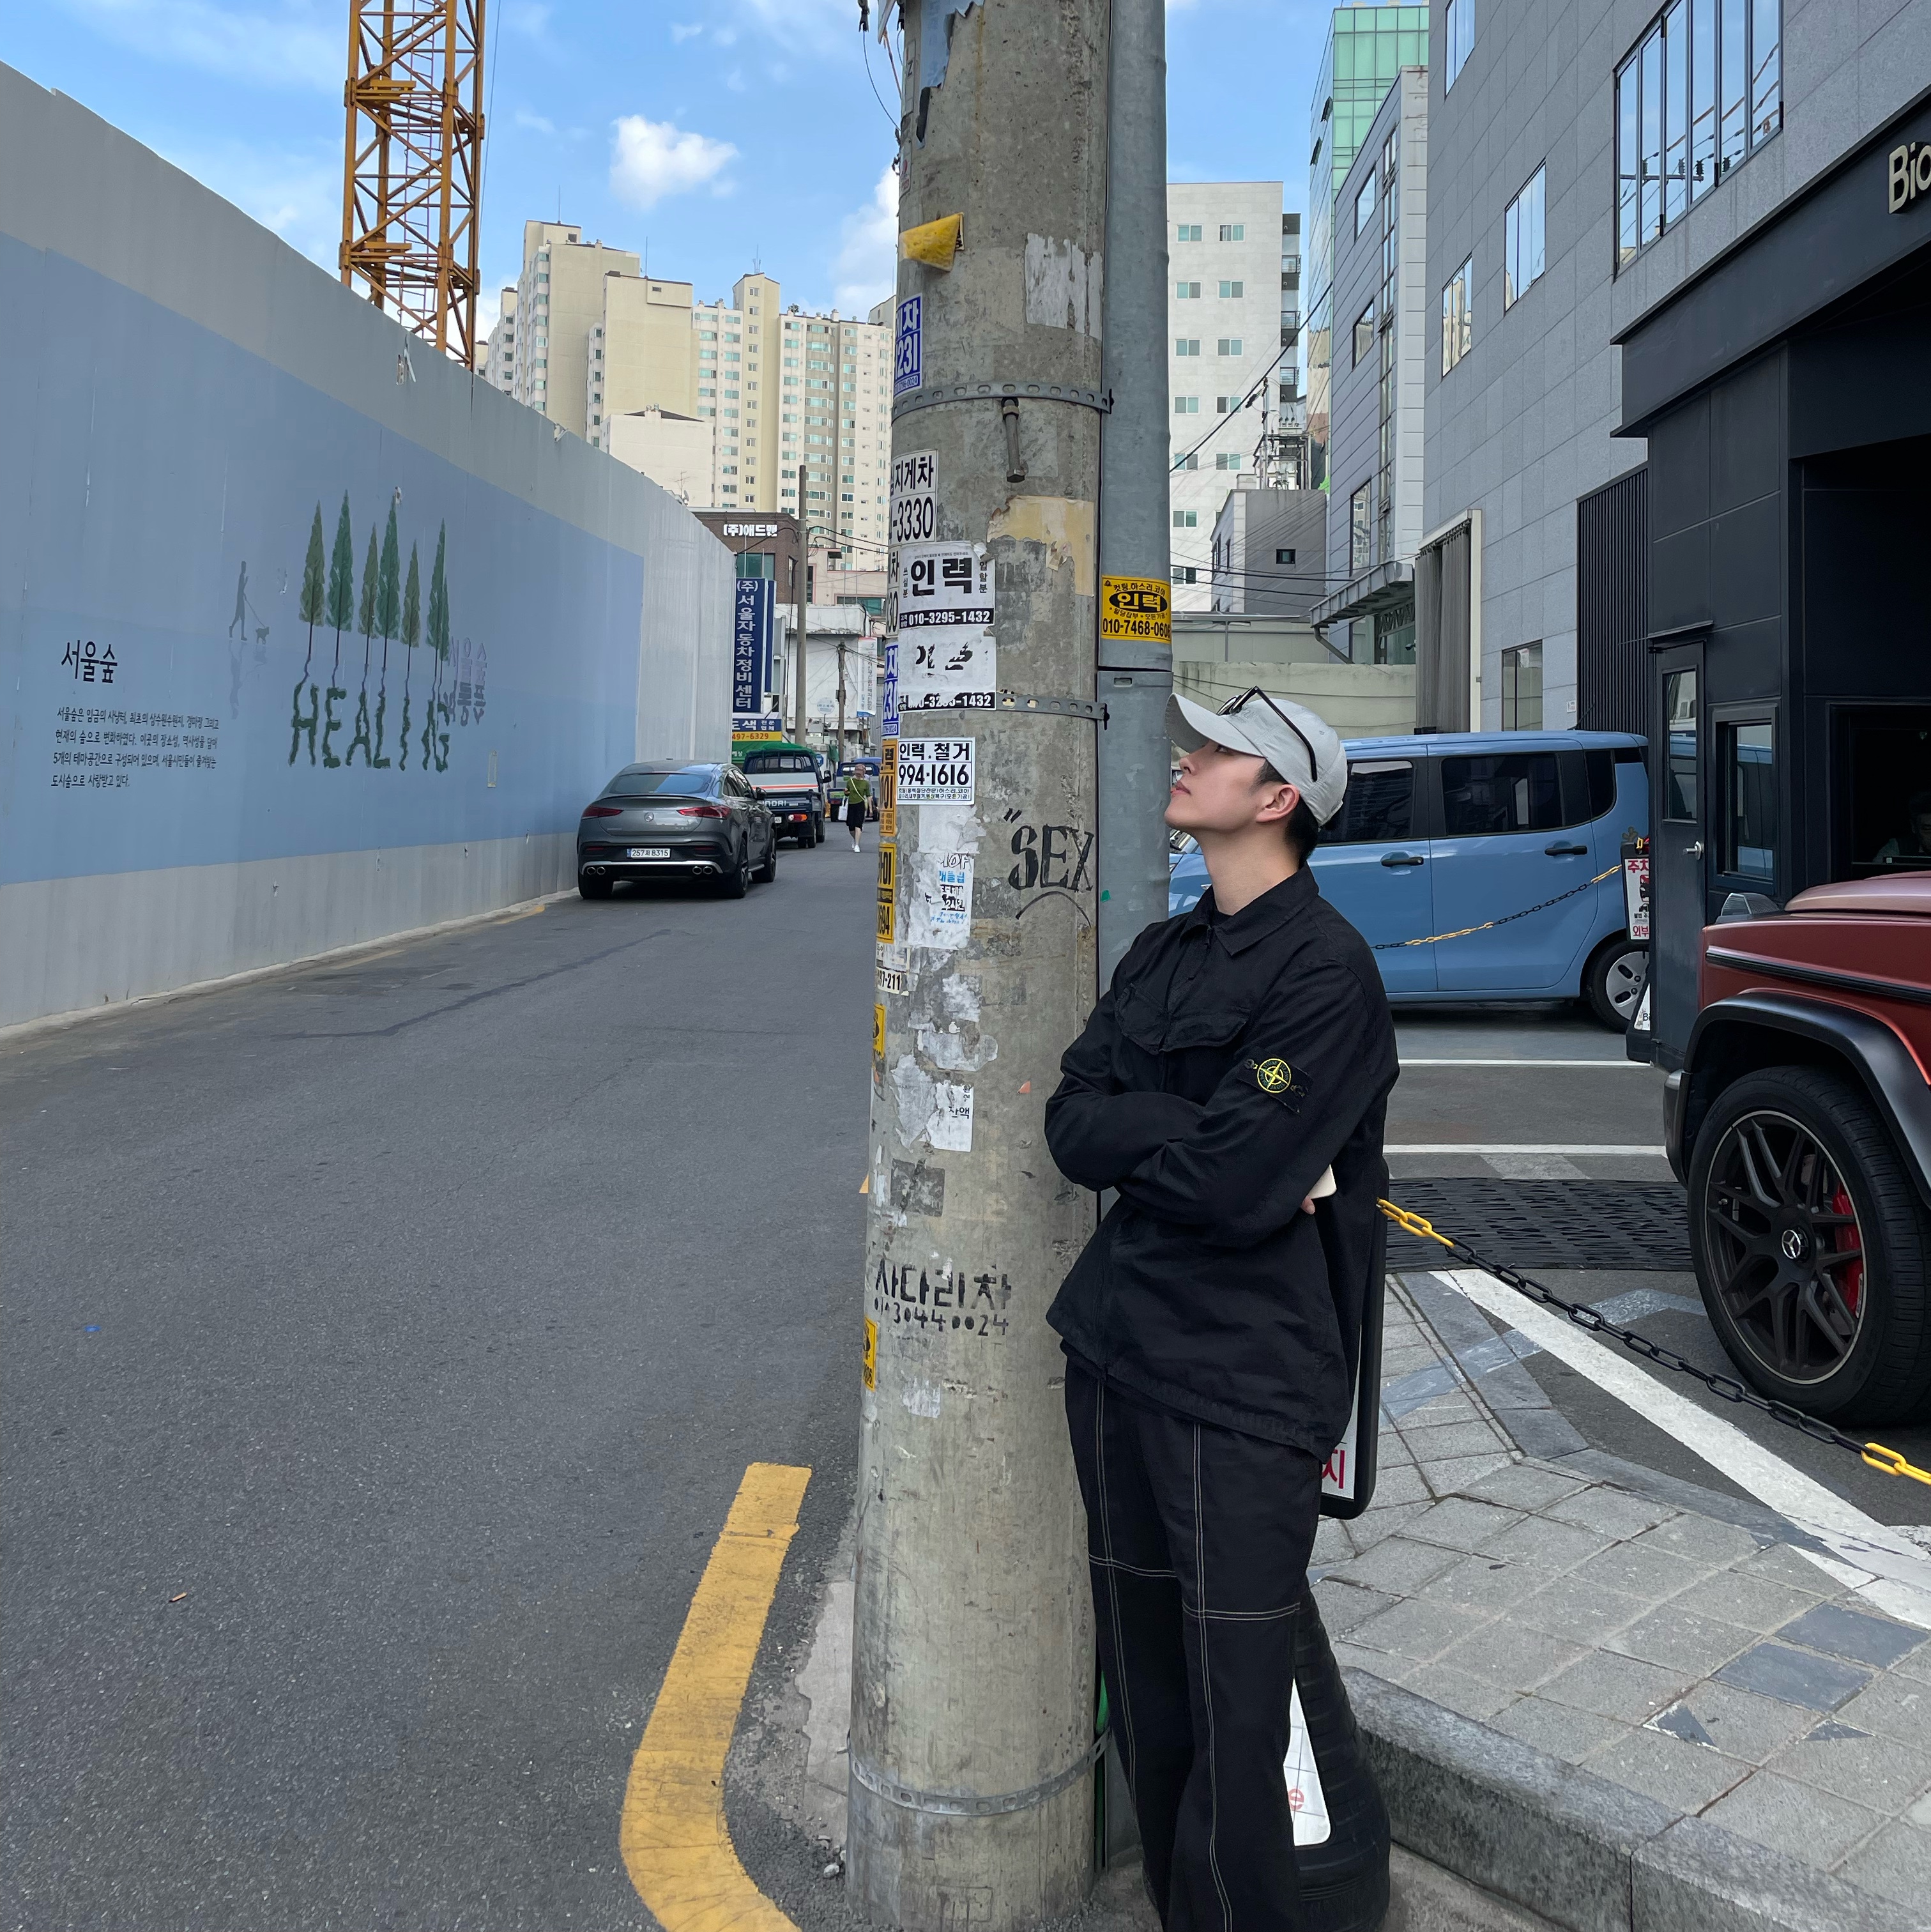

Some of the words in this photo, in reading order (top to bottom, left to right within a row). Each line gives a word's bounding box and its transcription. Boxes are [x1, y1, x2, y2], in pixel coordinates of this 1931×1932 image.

[1889, 142, 1931, 214] Bio
[723, 524, 777, 537] (주)애드맨
[911, 557, 972, 597] 인력
[1117, 592, 1161, 612] 인력
[908, 610, 991, 625] 010-3295-1432
[61, 640, 119, 684] 서울숲
[57, 706, 84, 722] 서울숲은
[86, 708, 107, 723] 임금의
[56, 728, 77, 744] 현재의
[79, 730, 100, 744] 숲으로
[140, 732, 158, 746] 이곳의
[288, 682, 450, 772] HEALING
[53, 751, 71, 765] 5개의
[73, 751, 112, 766] 테마공간으로
[50, 773, 86, 788] 도시숲으로
[88, 773, 114, 788] 사랑받고
[898, 763, 970, 785] 994-1616
[875, 1257, 1012, 1310] 사다리차
